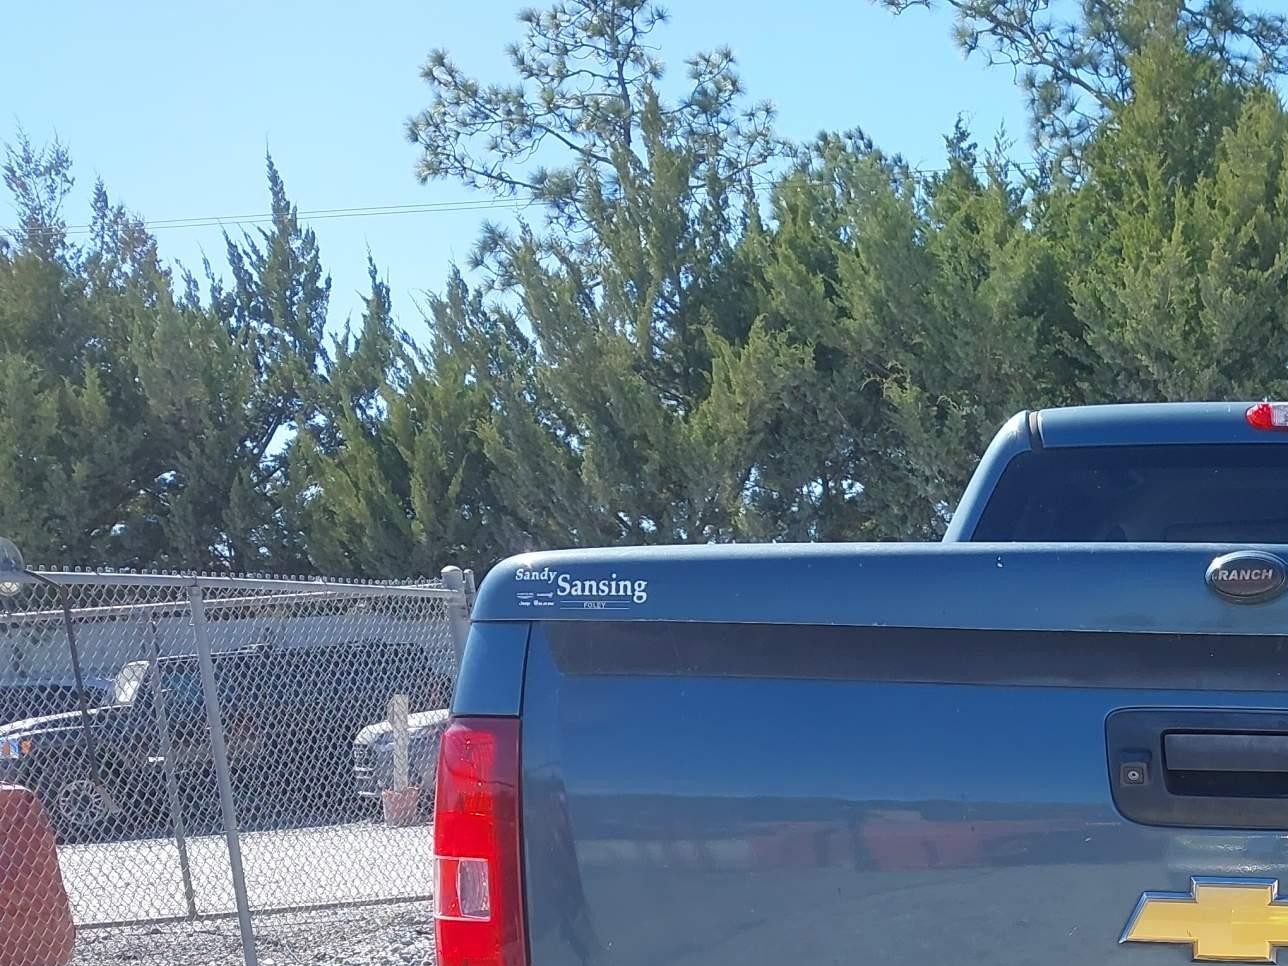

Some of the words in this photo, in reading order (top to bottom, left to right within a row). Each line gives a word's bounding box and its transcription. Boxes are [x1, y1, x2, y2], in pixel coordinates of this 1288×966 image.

[1218, 569, 1273, 581] RANCH
[515, 567, 557, 584] Sandy
[557, 573, 648, 604] Sansing
[583, 601, 607, 609] FOLEY
